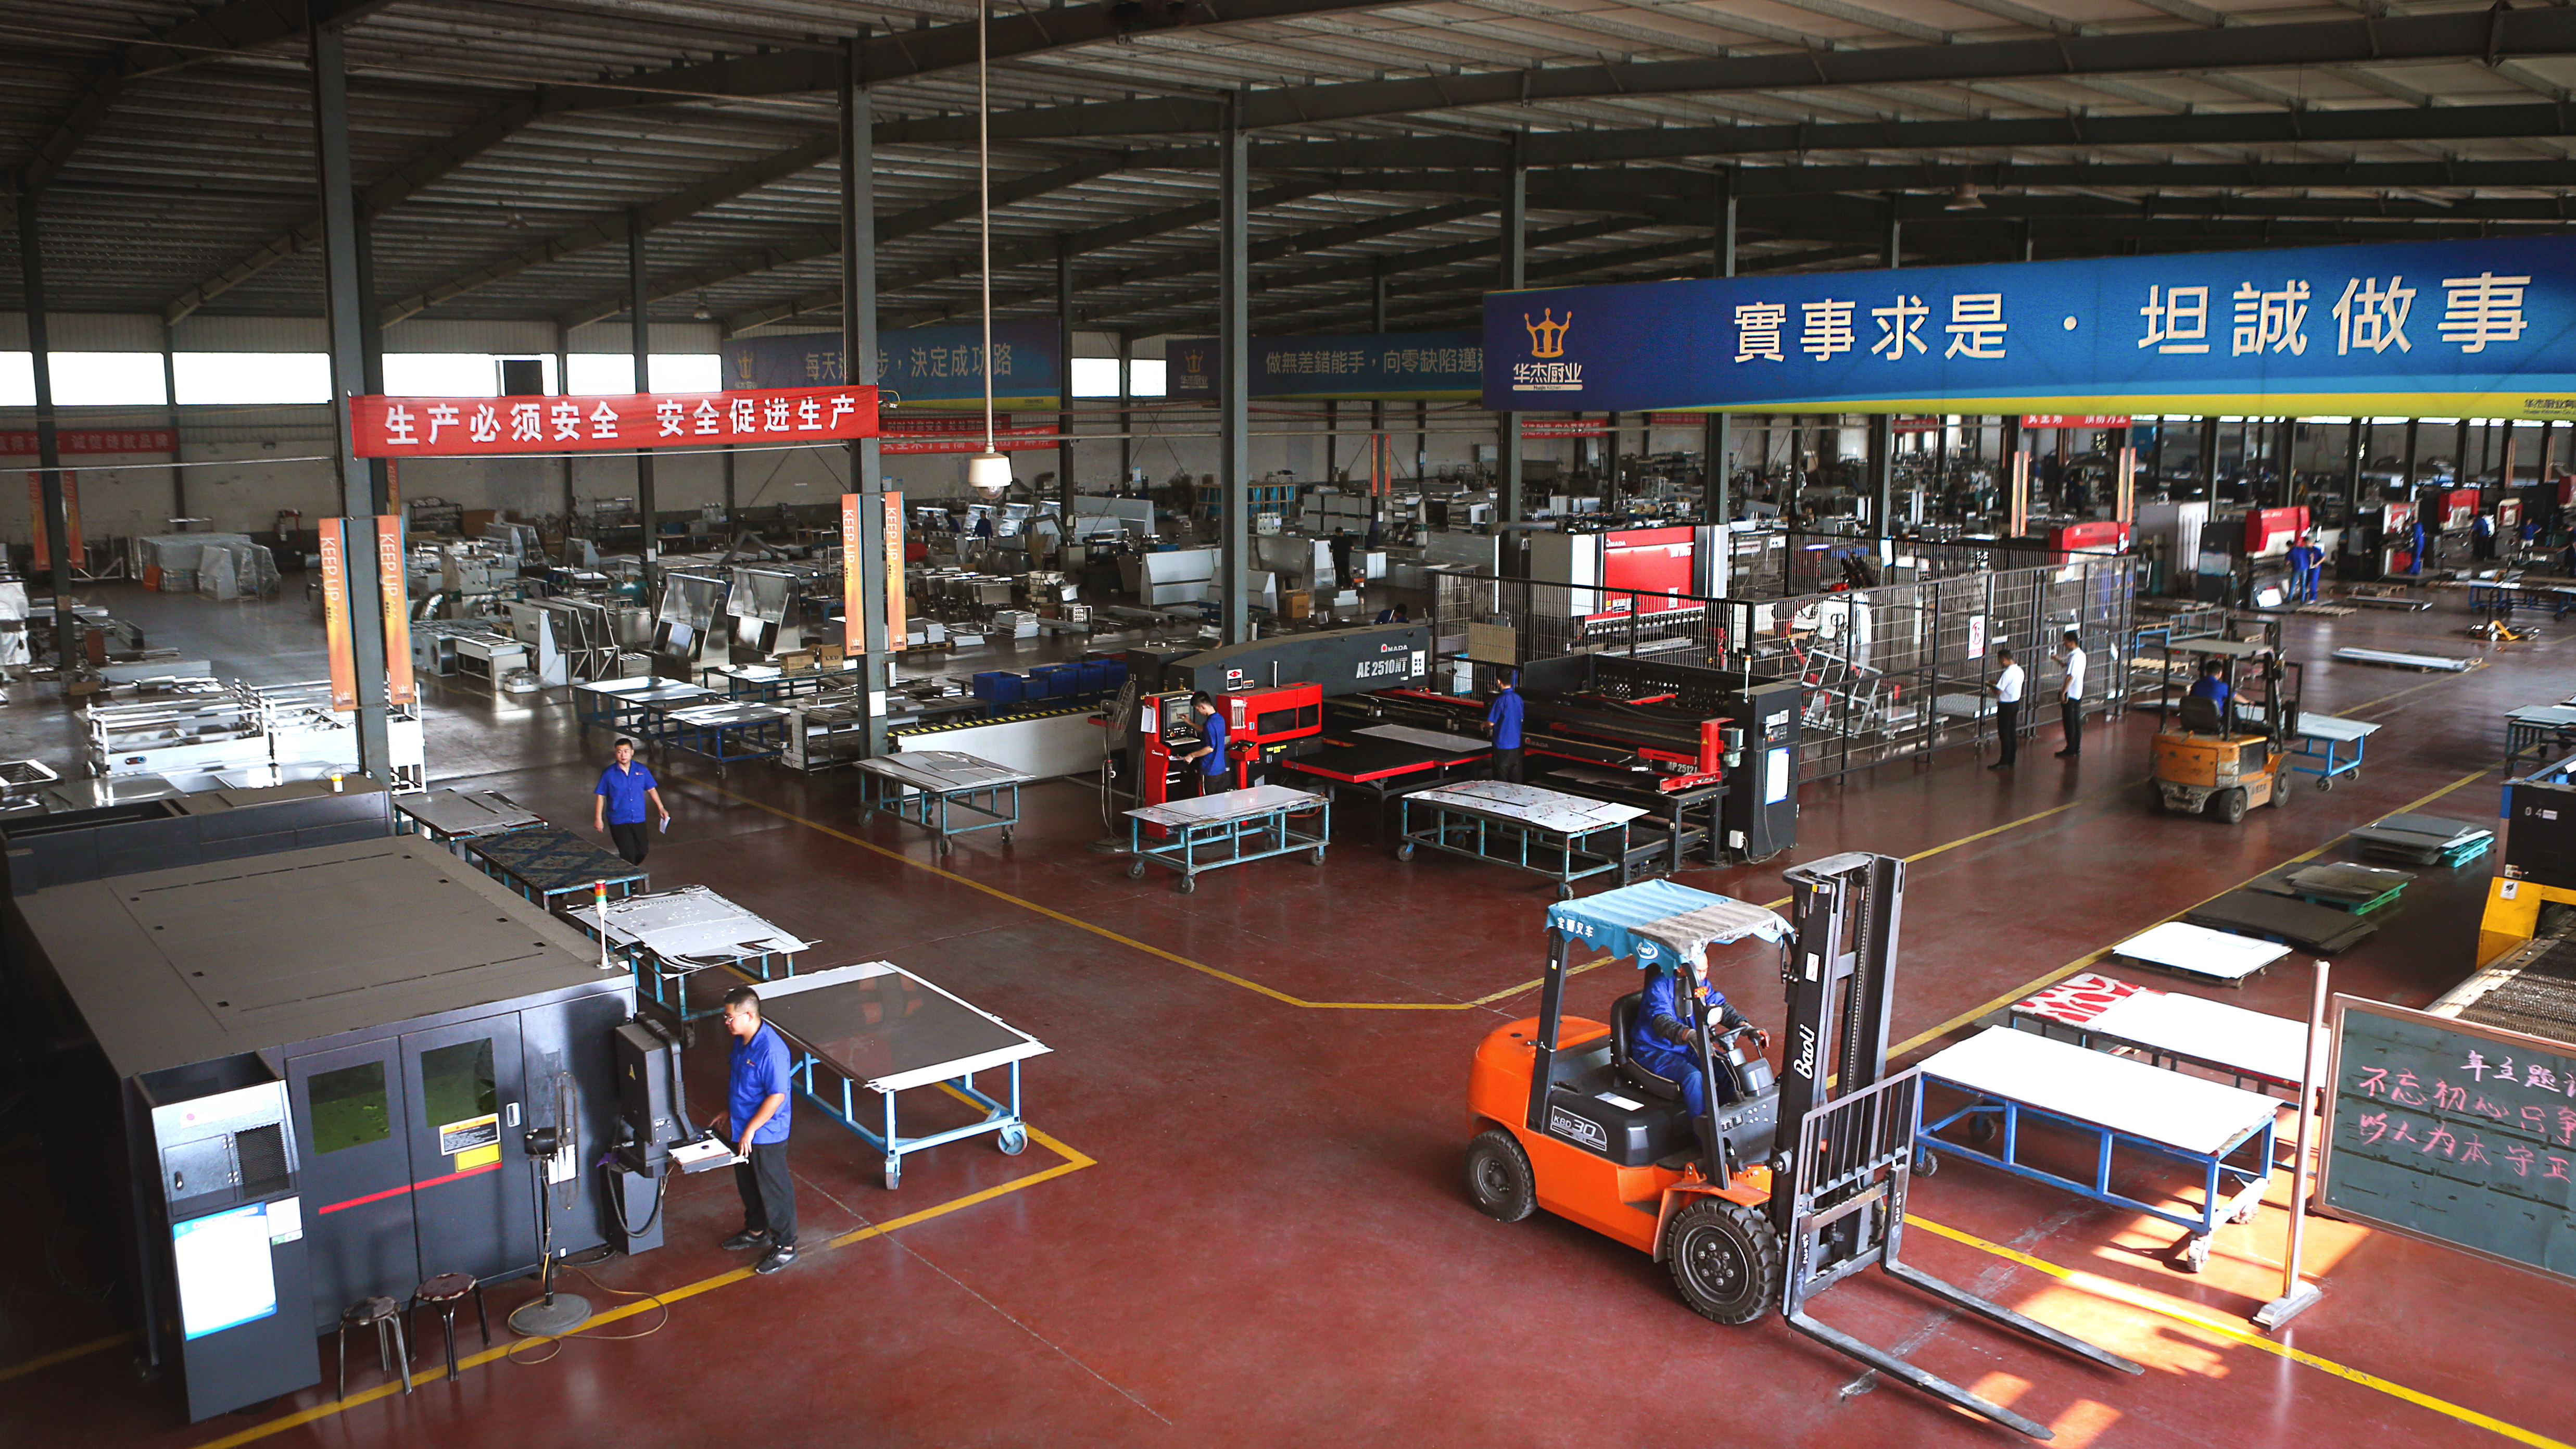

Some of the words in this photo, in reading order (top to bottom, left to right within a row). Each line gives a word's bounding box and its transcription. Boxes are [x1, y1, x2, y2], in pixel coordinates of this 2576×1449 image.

[1734, 293, 2007, 362] 實事求是
[2138, 271, 2532, 357] 坦誠做事
[1513, 362, 1582, 383] 华杰厨业
[384, 400, 620, 446] 生产必须安全
[655, 394, 855, 437] 安全促进生产
[843, 509, 854, 541] KEEP
[886, 507, 898, 539] KEEP
[320, 537, 337, 575] KEEP
[380, 533, 397, 571] KEEP
[844, 545, 855, 563] UP
[887, 542, 898, 560] UP
[323, 578, 340, 601] UP
[383, 575, 399, 596] UP
[1381, 643, 1408, 653] AMADA
[1356, 661, 1370, 679] AE
[1371, 657, 1408, 677] 2510NT
[1794, 1023, 1815, 1080] Baoli
[1554, 1114, 1572, 1129] KBD
[1572, 1118, 1597, 1138] 30
